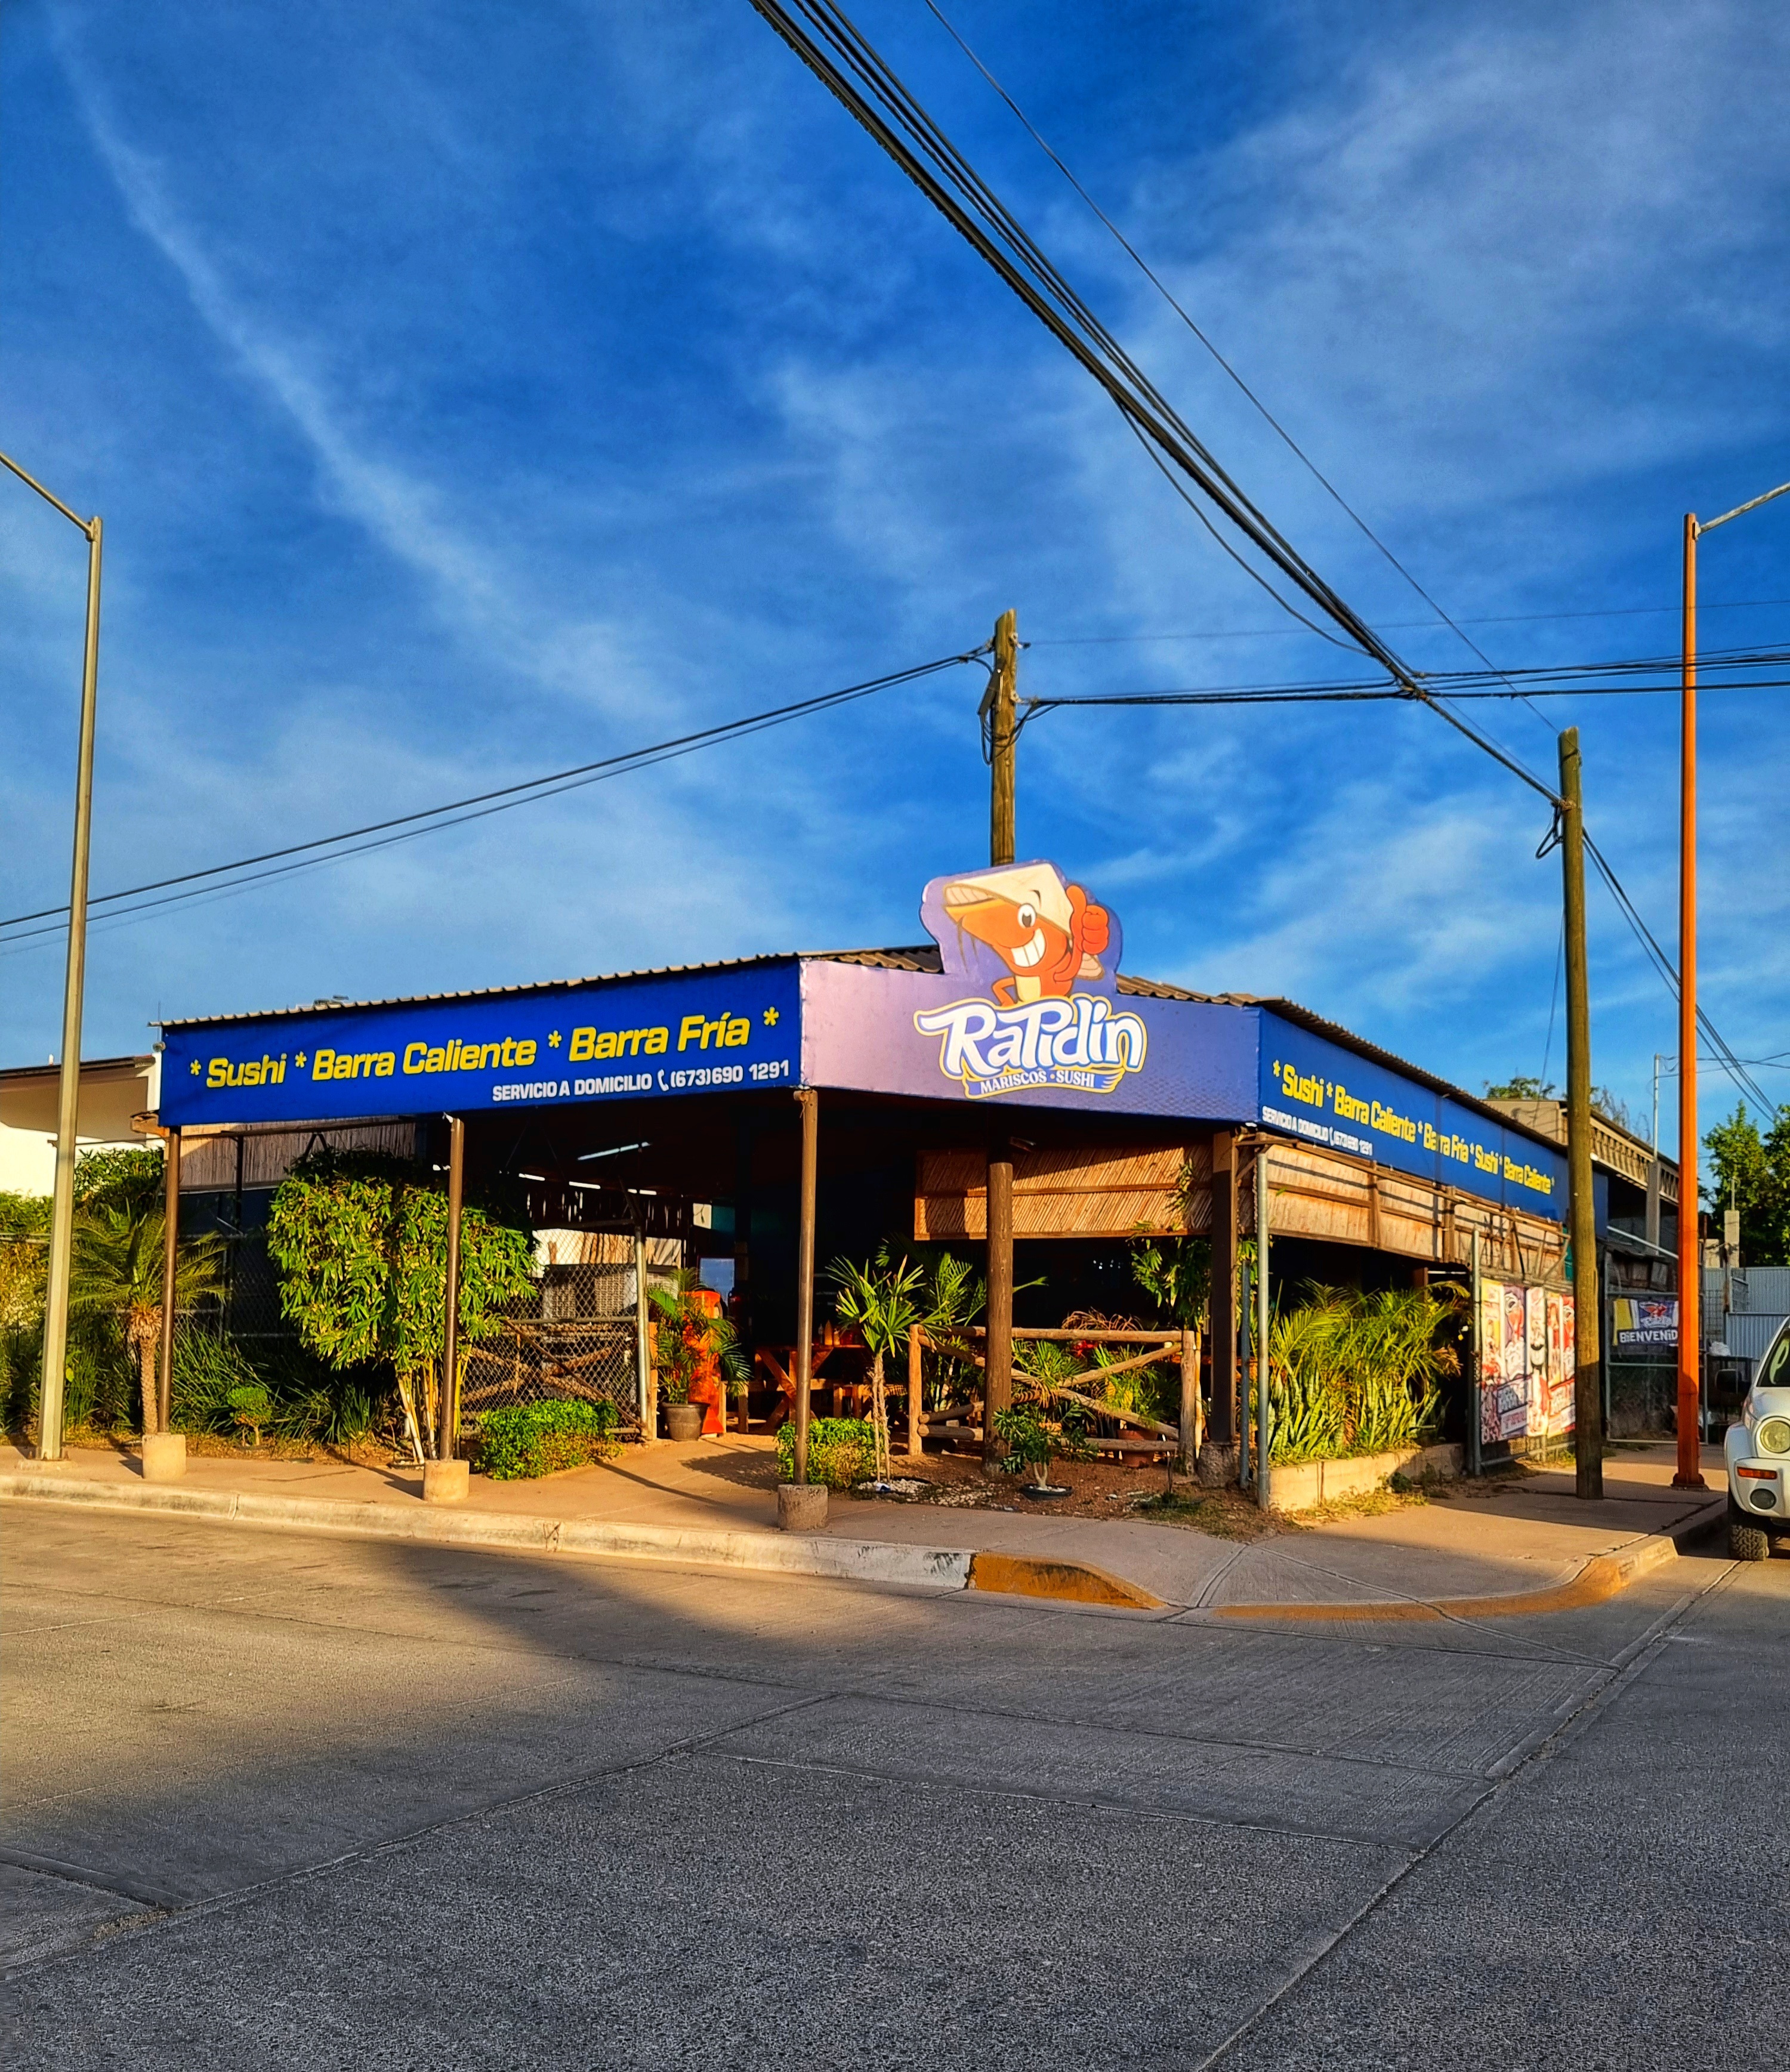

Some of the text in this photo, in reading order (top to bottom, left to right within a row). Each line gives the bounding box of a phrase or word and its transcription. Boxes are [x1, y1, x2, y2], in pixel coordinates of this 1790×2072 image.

[206, 1012, 751, 1088] Sushi Barra Caliente Barra Fría
[492, 1081, 557, 1102] SERVICIO
[558, 1080, 570, 1097] A
[574, 1073, 652, 1095] DOMICILIO
[749, 1060, 789, 1080] 1291
[980, 1070, 1095, 1094] MARISCOS SUSHI
[1282, 1064, 1324, 1108] Sushi
[1334, 1084, 1370, 1125] Barra
[1371, 1100, 1416, 1143] Caliente
[1474, 1144, 1499, 1175] Sushi
